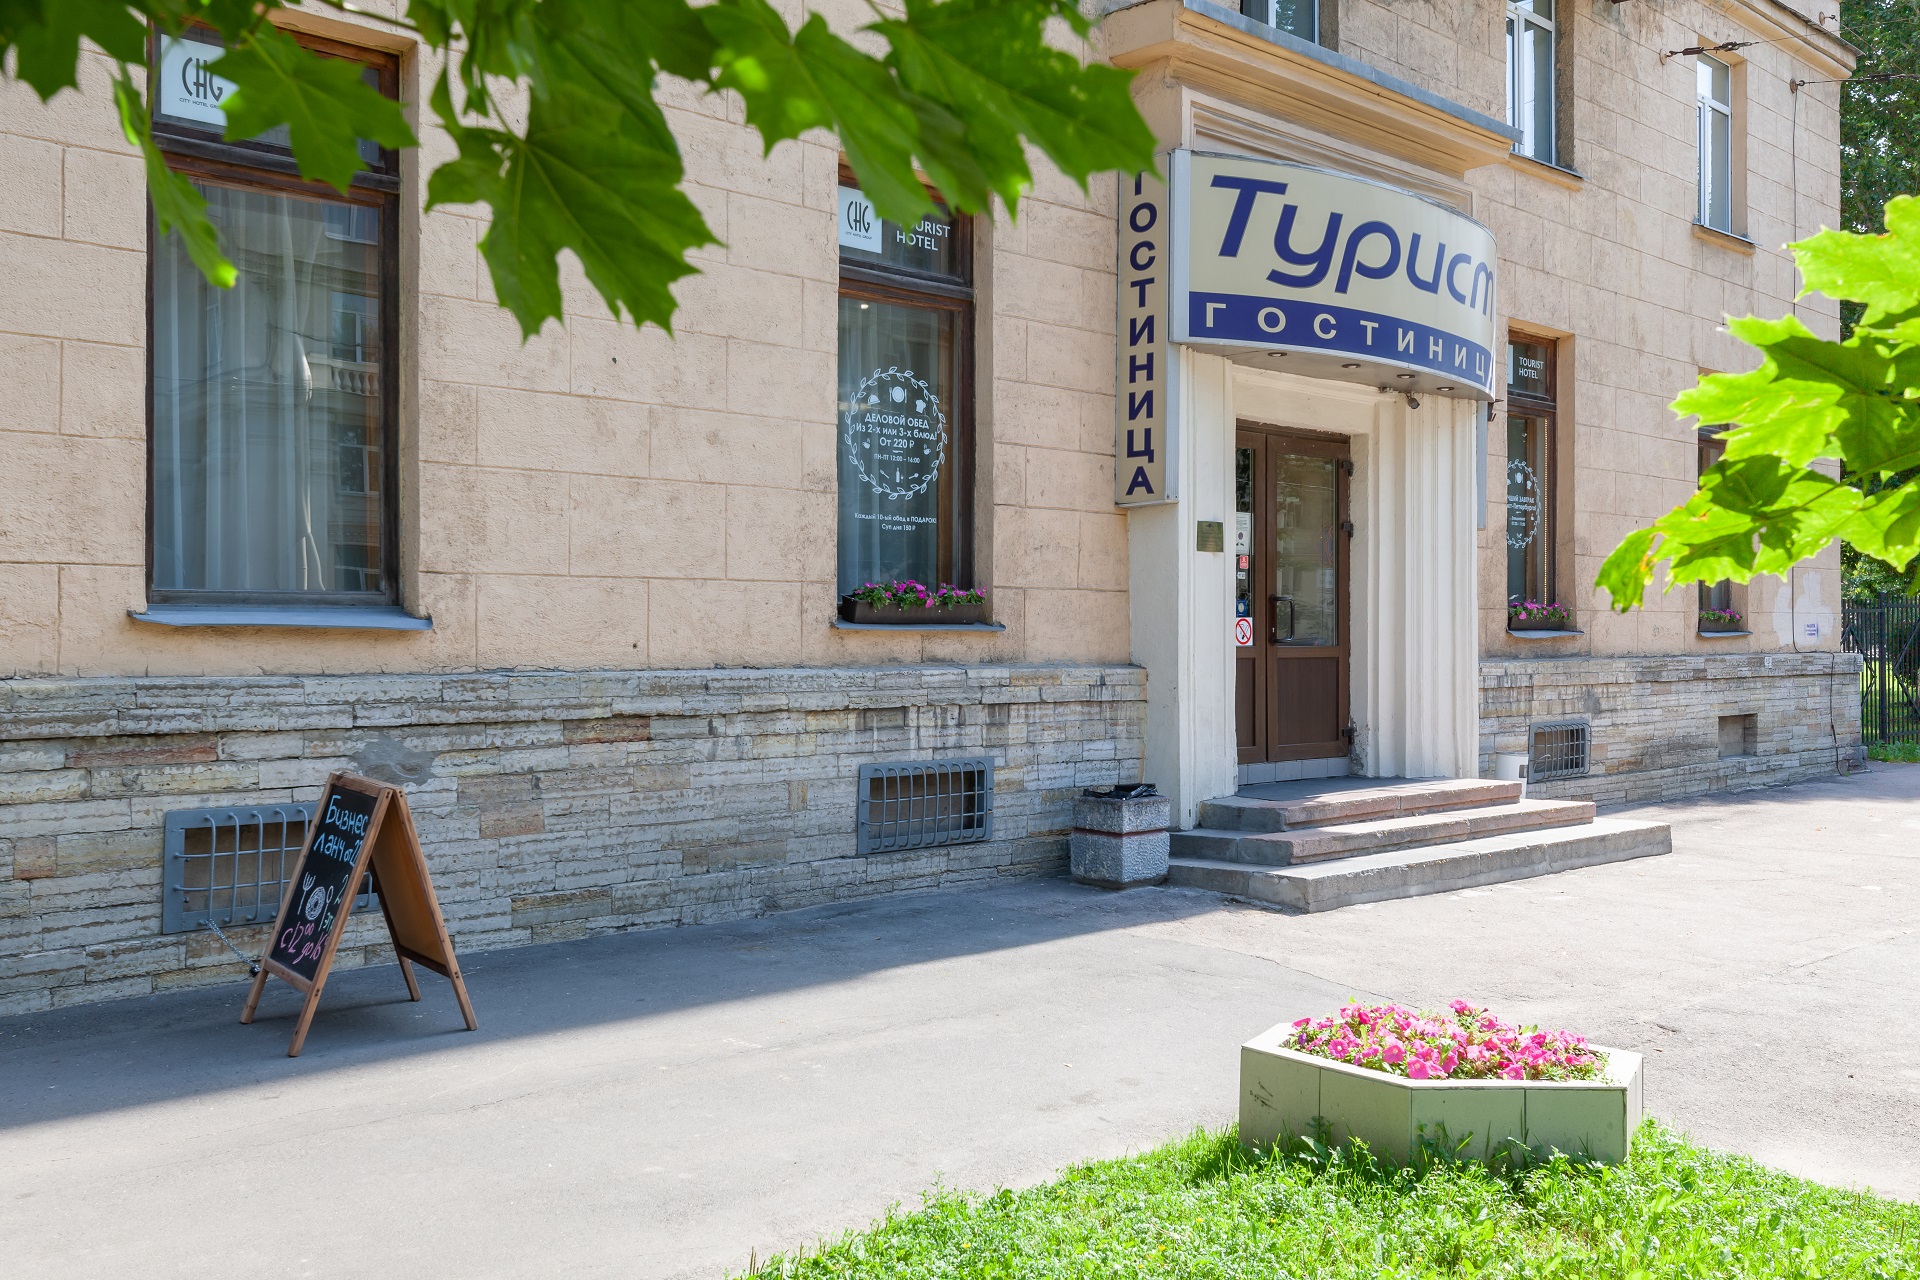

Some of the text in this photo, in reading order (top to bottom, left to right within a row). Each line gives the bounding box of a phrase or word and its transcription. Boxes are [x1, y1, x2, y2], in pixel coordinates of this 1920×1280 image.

[182, 57, 223, 102] CHG
[847, 200, 870, 234] CHG
[899, 220, 951, 239] URIST
[896, 230, 939, 252] HOTEL
[1209, 173, 1495, 324] Турист
[1205, 302, 1486, 383] ГОСТИНИЦ
[1519, 356, 1545, 370] TOURIST
[1518, 367, 1539, 380] HOTEL
[855, 422, 866, 432] Из
[867, 423, 881, 435] 2-х
[882, 427, 898, 436] или
[899, 427, 912, 438] 3-х
[864, 412, 930, 430] ДЕЛОВОЙ ОБЕД
[880, 437, 892, 446] От
[893, 438, 908, 449] 220
[890, 454, 903, 462] 12:00
[325, 794, 369, 837] Бизнес
